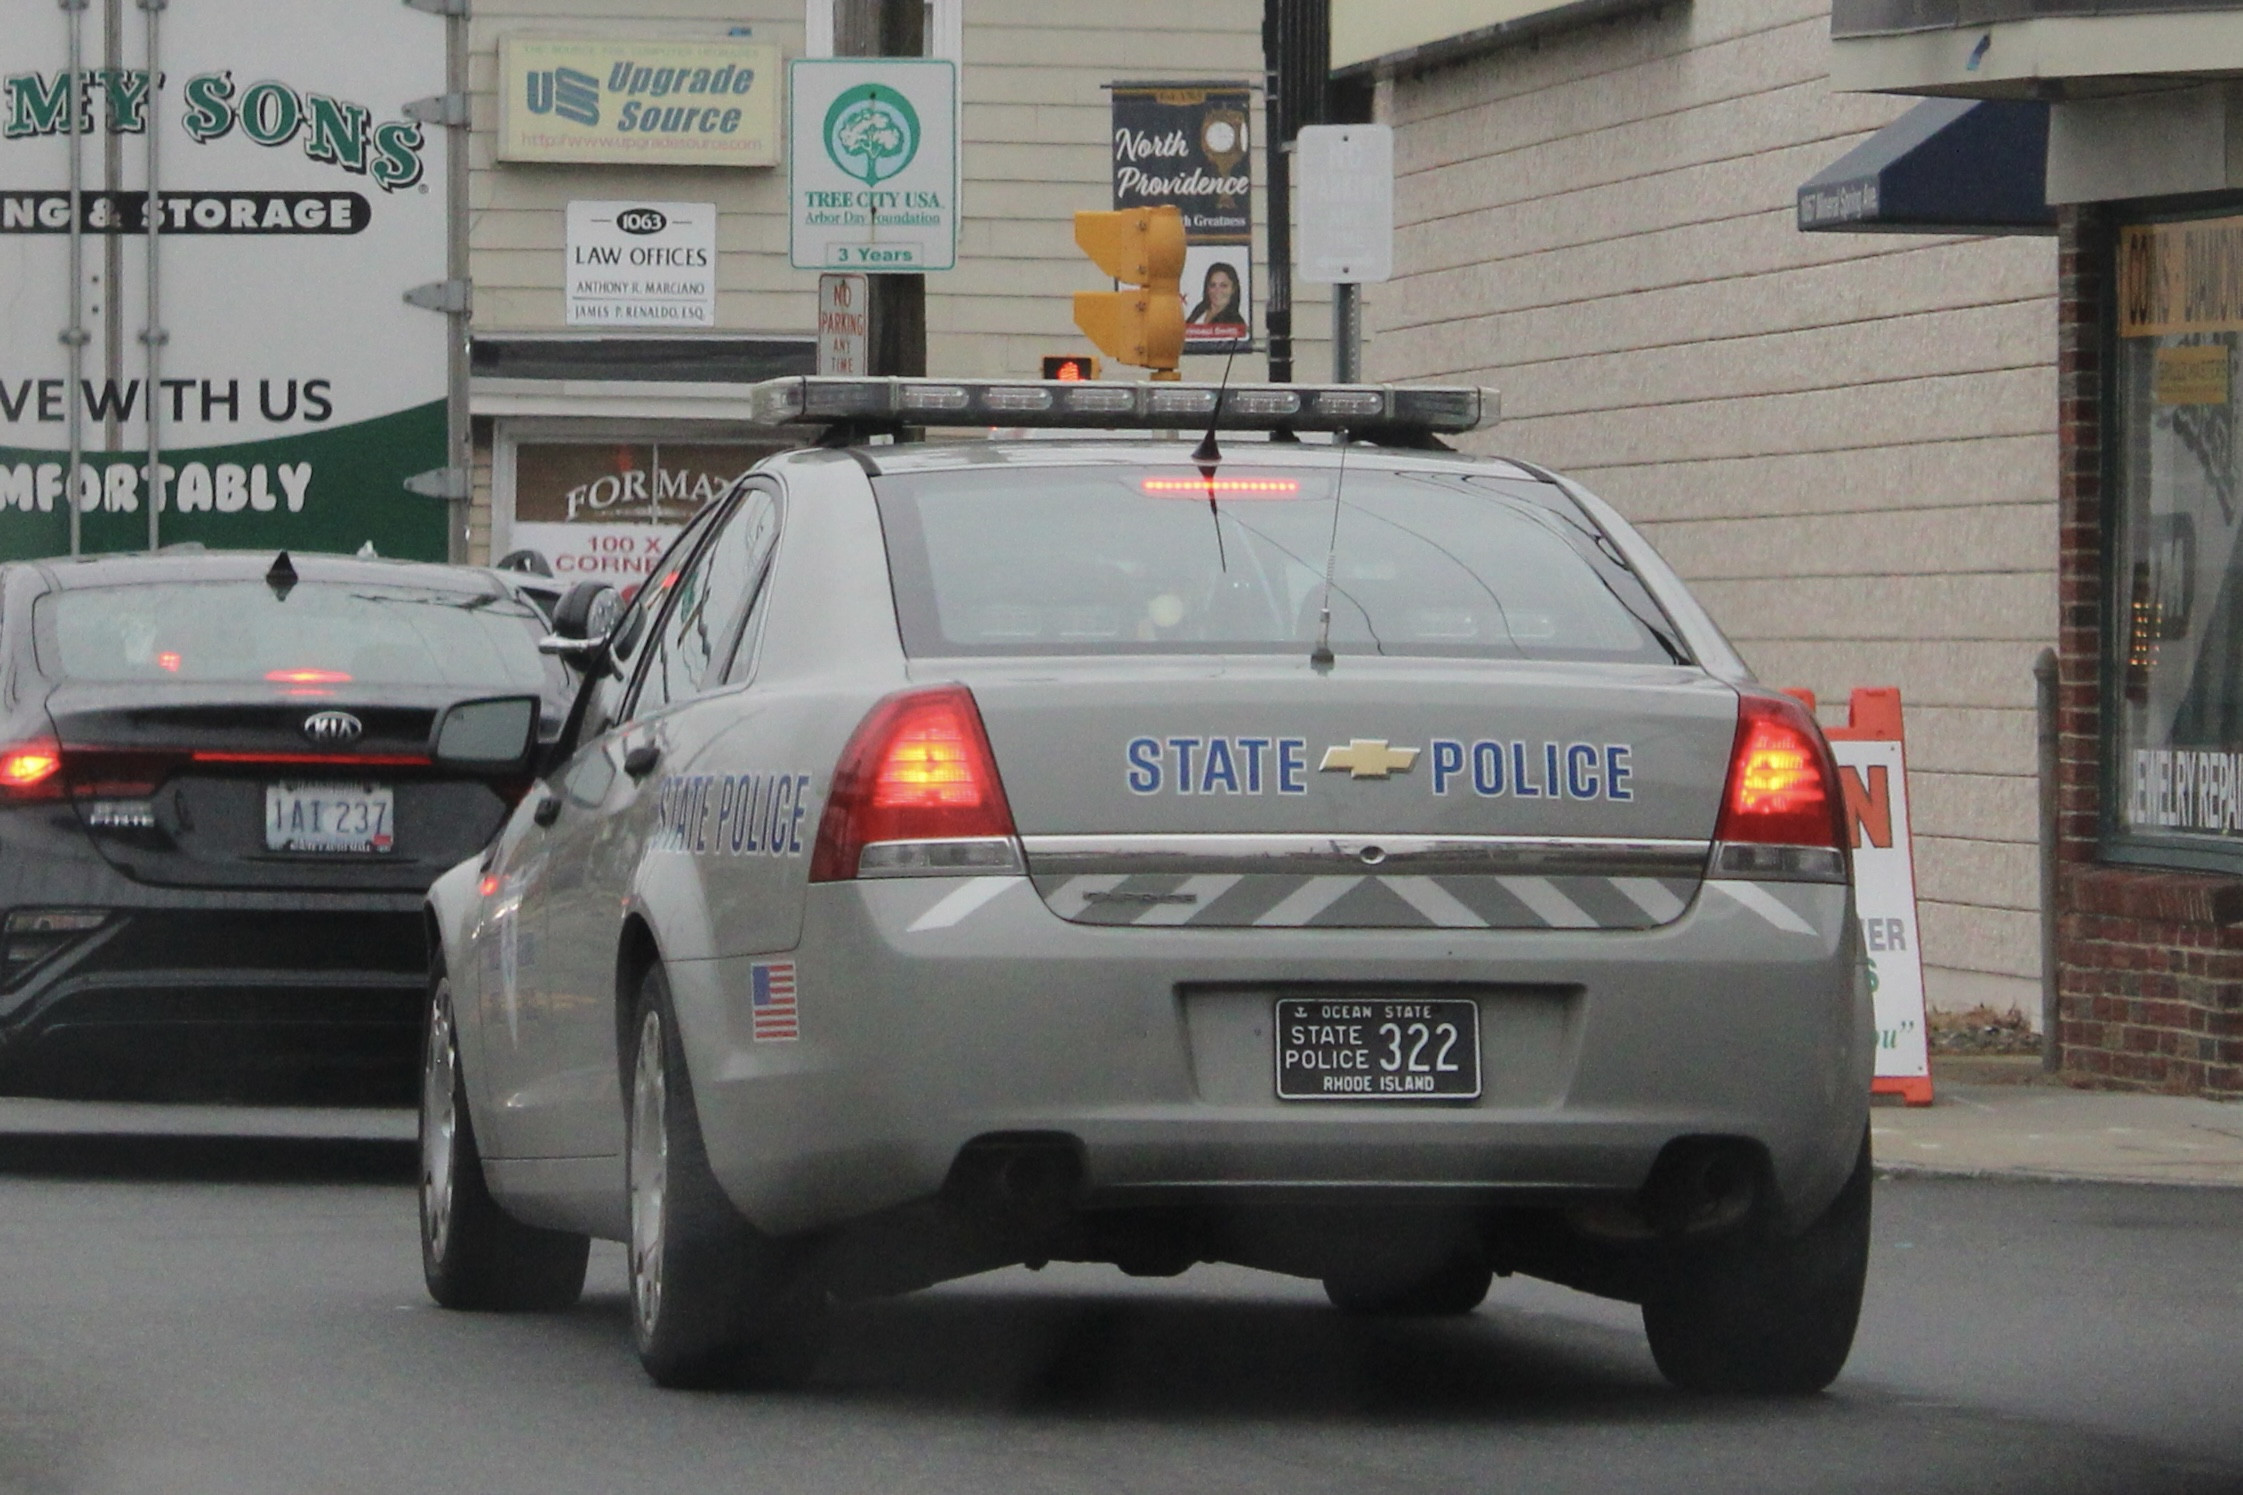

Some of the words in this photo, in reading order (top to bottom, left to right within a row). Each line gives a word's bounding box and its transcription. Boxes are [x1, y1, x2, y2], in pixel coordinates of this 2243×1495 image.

[607, 61, 755, 97] Upgrade
[617, 100, 742, 133] Source
[4, 70, 164, 138] MY
[182, 70, 425, 194] SONS
[1115, 127, 1189, 162] North
[1117, 166, 1249, 198] Providence
[805, 191, 853, 208] TREE
[856, 191, 900, 208] CITY
[905, 191, 940, 208] USA
[141, 198, 353, 229] STORAGE
[622, 213, 663, 230] 1063
[806, 210, 840, 225] Arbor
[844, 210, 865, 227] Day
[1193, 214, 1247, 227] Greatness
[575, 246, 622, 266] LAW
[630, 246, 708, 267] OFFICES
[839, 248, 848, 262] 3
[858, 248, 913, 262] Years
[576, 280, 628, 295] ANTHONY
[645, 281, 705, 295] MARCIANO
[834, 285, 852, 308] NO
[575, 305, 610, 319] JAMES
[821, 311, 864, 337] PARKING
[833, 337, 850, 354] ANY
[831, 356, 853, 373] TIME
[259, 379, 333, 422] US
[588, 536, 635, 553] 100
[313, 718, 353, 739] KIA
[1126, 736, 1308, 796] STATE
[1430, 738, 1635, 802] POLICE
[336, 800, 387, 834] 237
[657, 774, 715, 853] STATE
[715, 771, 812, 857] POLICE
[1321, 1005, 1373, 1019] OCEAN
[1384, 1005, 1433, 1019] STATE
[1291, 1025, 1363, 1045] STATE
[1378, 1022, 1460, 1072] 322
[1285, 1050, 1370, 1070] POLICE
[1323, 1075, 1373, 1092] RHODE
[1380, 1075, 1435, 1092] ISLAND
